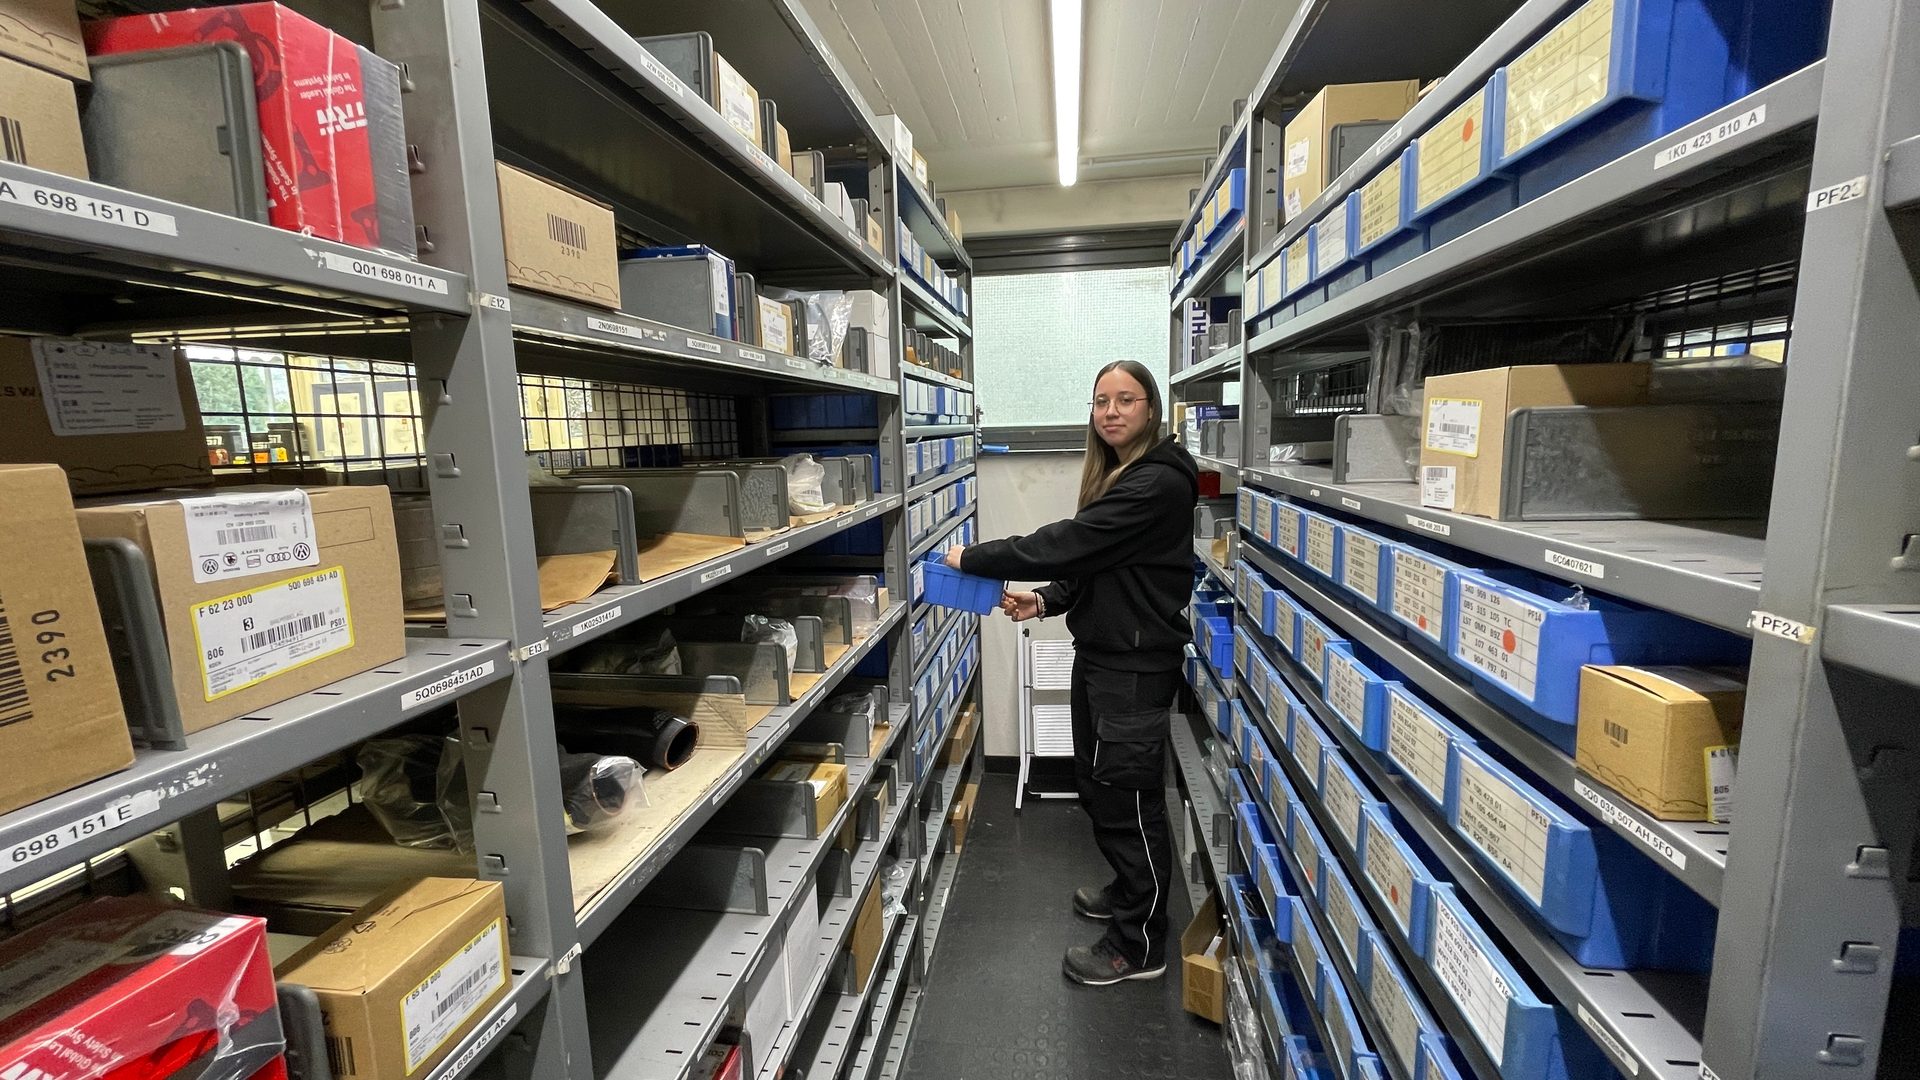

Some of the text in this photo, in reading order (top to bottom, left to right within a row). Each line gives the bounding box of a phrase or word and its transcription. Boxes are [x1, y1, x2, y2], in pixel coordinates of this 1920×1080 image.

[1668, 112, 1758, 162] 1K0 423 810 A
[34, 190, 78, 212] 698
[88, 202, 124, 222] 151
[134, 211, 150, 226] D
[561, 246, 581, 260] 2390
[353, 262, 436, 290] Q01 698 011 A
[492, 298, 504, 309] E12
[1192, 301, 1206, 365] HLE
[329, 571, 338, 580] AD
[199, 594, 254, 618] F 62 23 000
[1504, 616, 1511, 628] TC
[1761, 616, 1800, 638] PF24
[1462, 632, 1466, 640] N
[32, 610, 75, 682] 2390
[207, 646, 224, 660] 806
[528, 643, 542, 657] E13
[1460, 647, 1466, 656] N
[416, 666, 484, 702] 5Q0698451AD
[1466, 778, 1471, 787] N
[1469, 796, 1474, 805] N
[1531, 810, 1548, 828] PF15
[12, 804, 132, 862] 698 151 E
[1600, 800, 1616, 816] 035
[1617, 812, 1633, 828] 507
[1635, 822, 1650, 842] AH
[1653, 836, 1674, 858] 5FQ
[1502, 857, 1513, 872] AA
[405, 996, 410, 1006] F
[435, 992, 439, 1001] 1
[456, 1048, 474, 1070] 698
[476, 1031, 492, 1050] 451
[494, 1016, 507, 1032] AK
